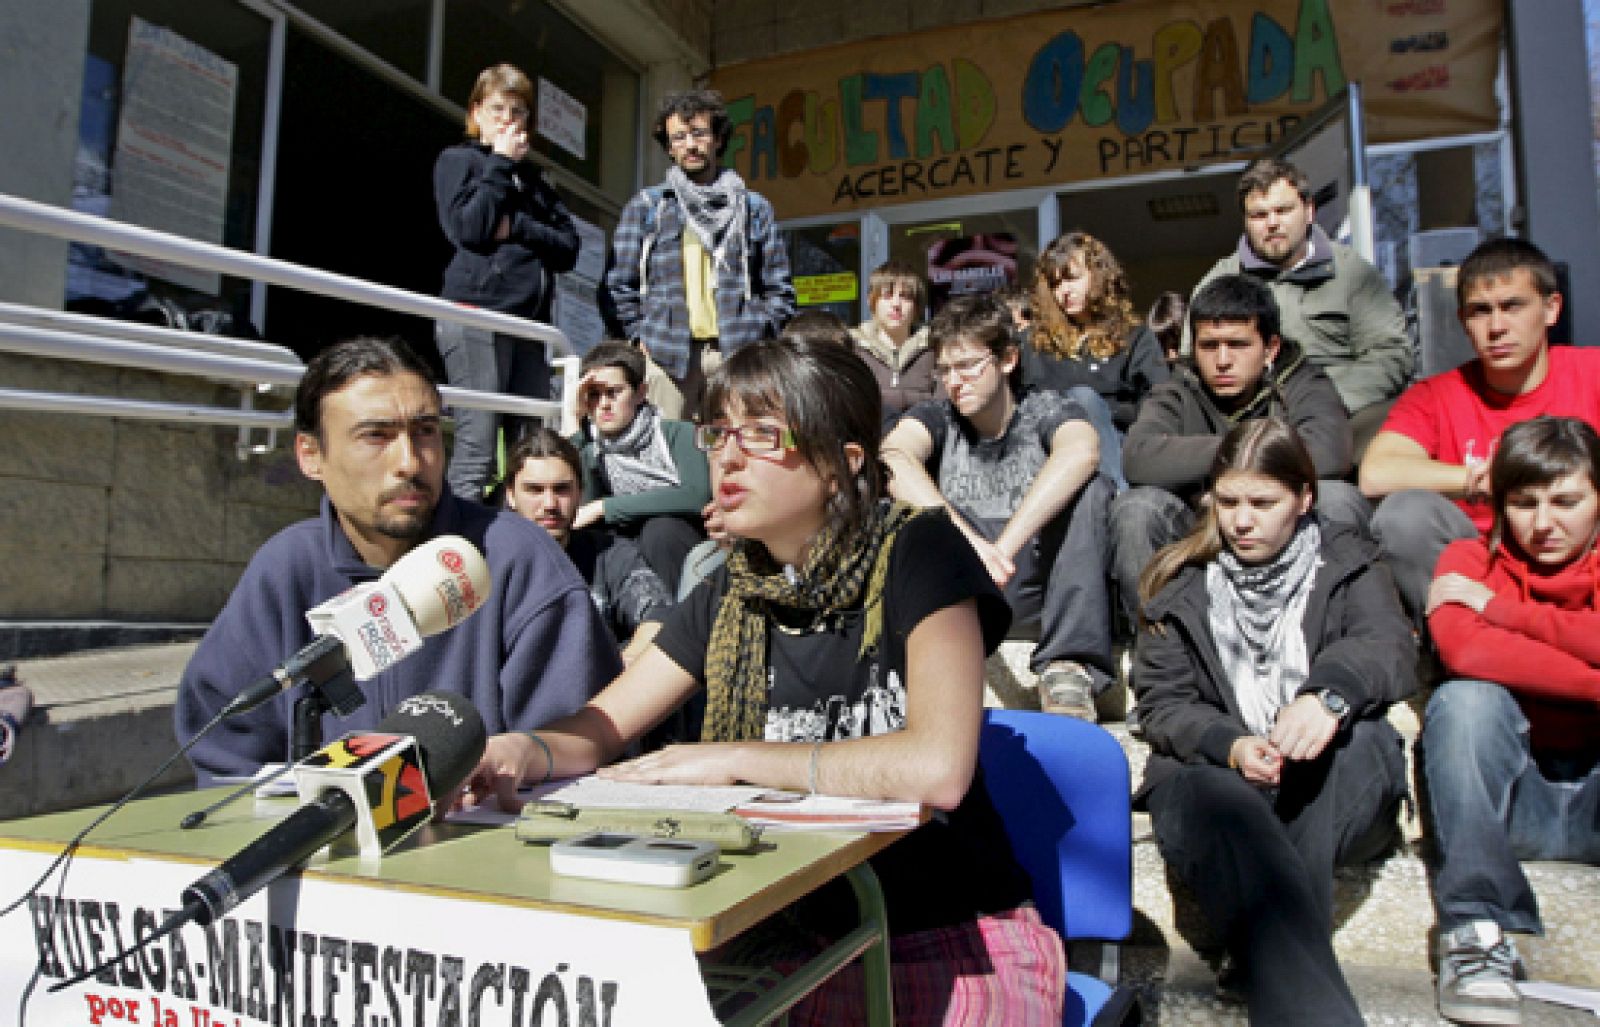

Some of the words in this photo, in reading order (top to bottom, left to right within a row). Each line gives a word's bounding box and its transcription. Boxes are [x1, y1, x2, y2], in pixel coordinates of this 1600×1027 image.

[723, 58, 996, 181] FACULTAD
[1022, 0, 1347, 134] OCUPADA
[833, 144, 1027, 204] ACERCATE
[1042, 136, 1063, 175] Y
[84, 993, 140, 1025] por
[150, 997, 179, 1027] la
